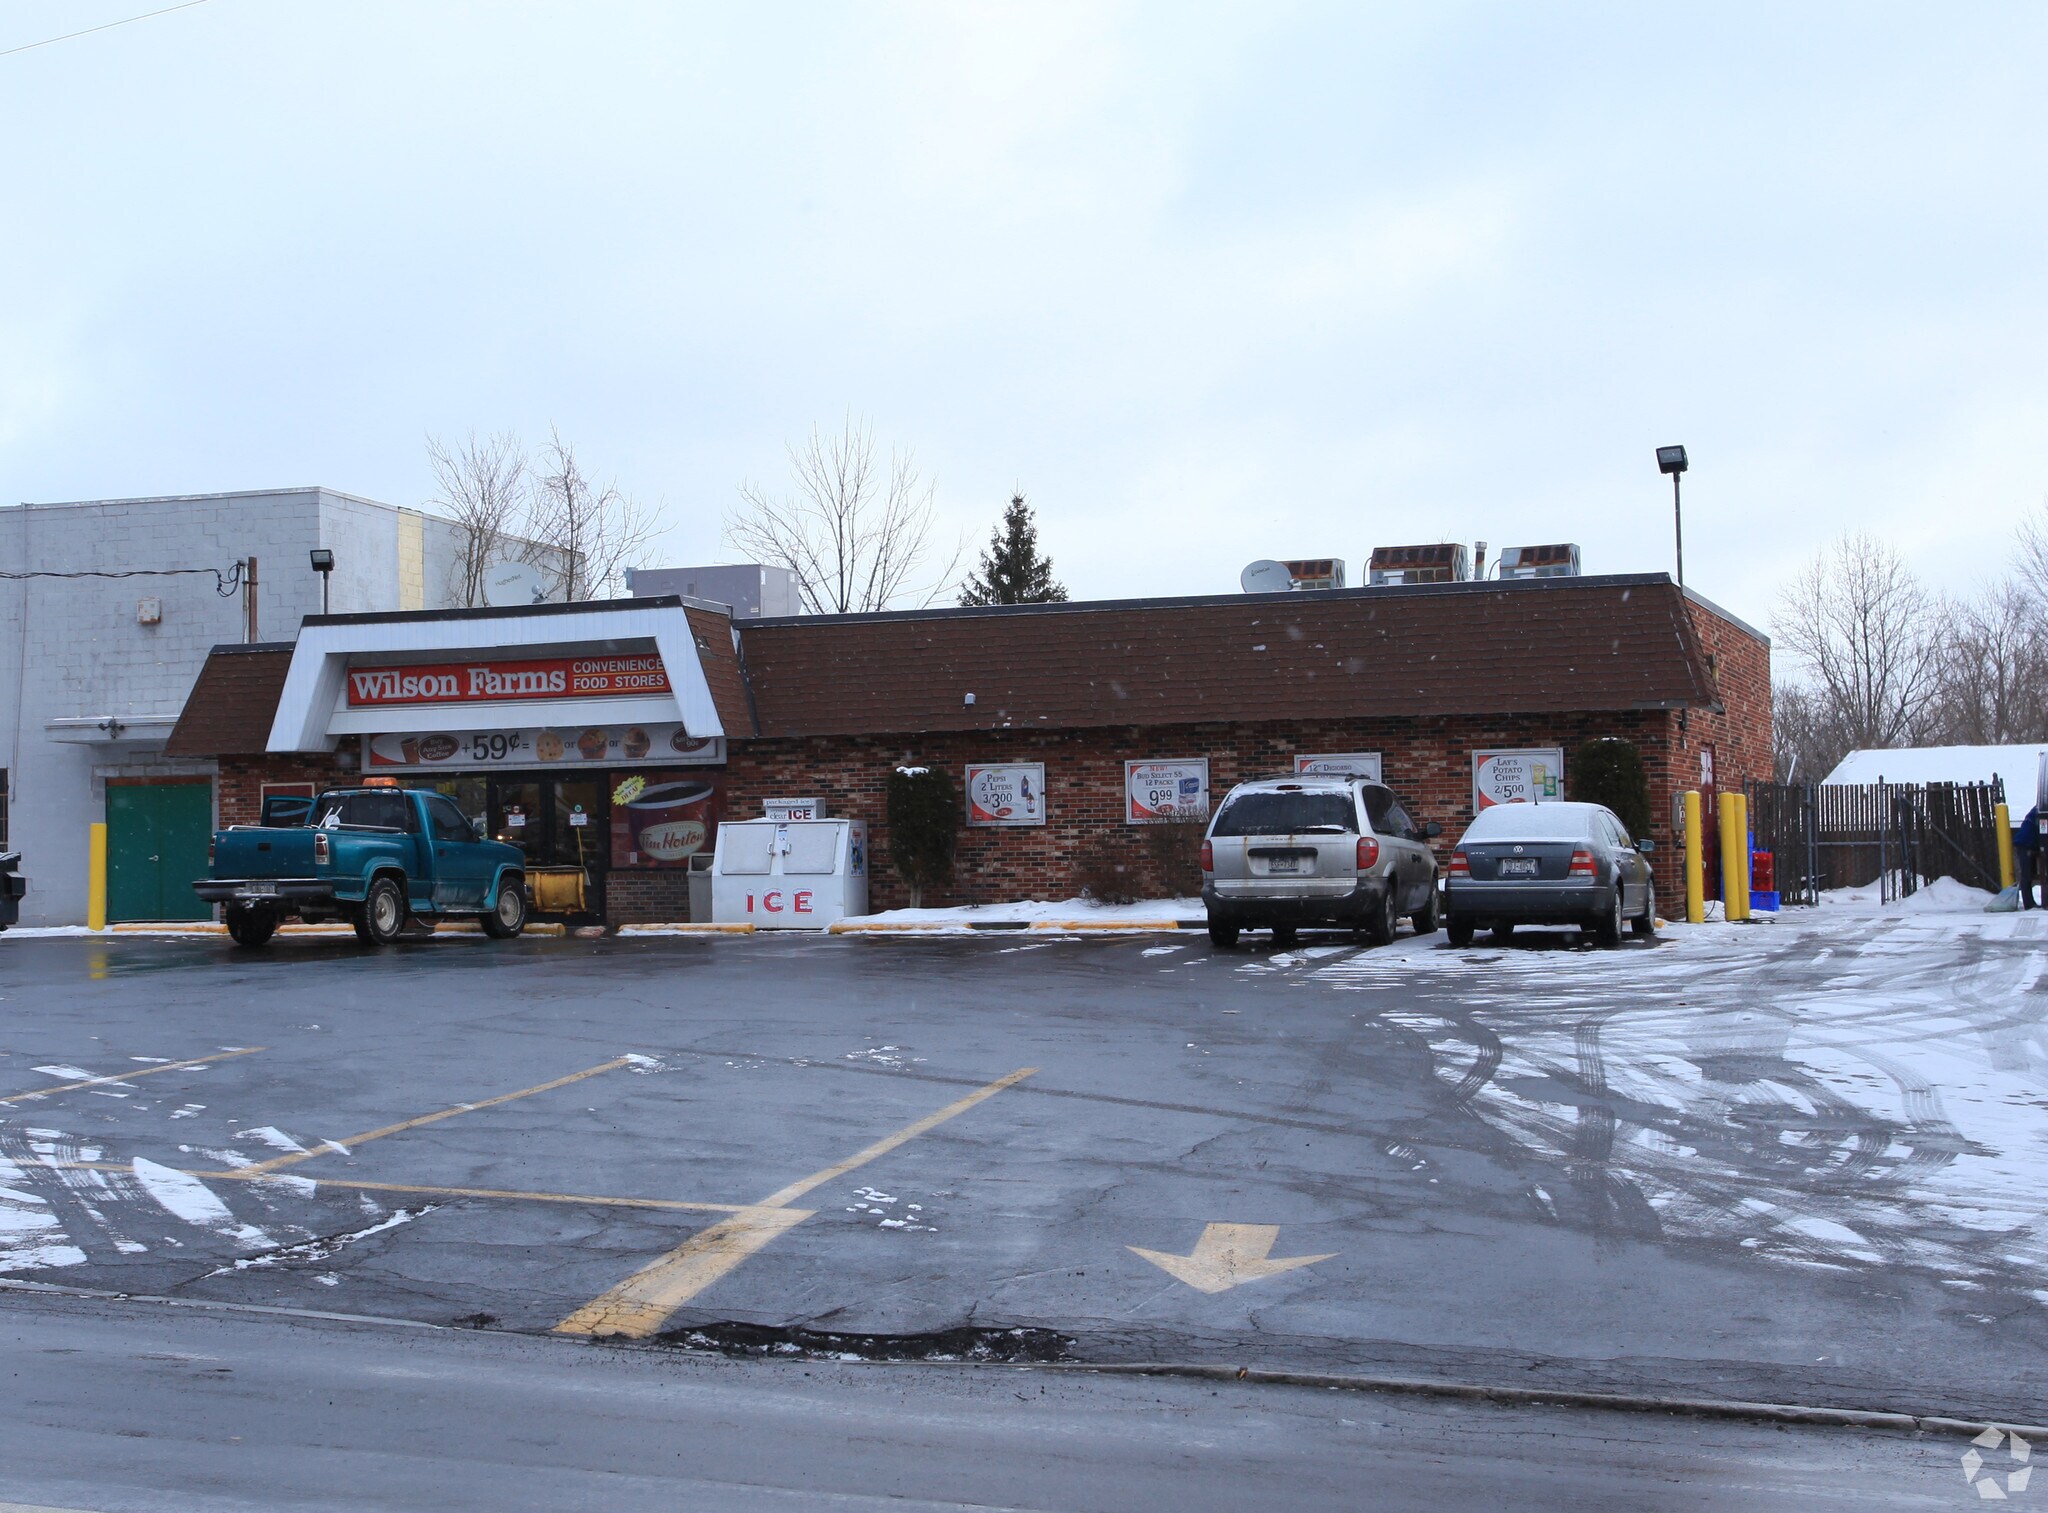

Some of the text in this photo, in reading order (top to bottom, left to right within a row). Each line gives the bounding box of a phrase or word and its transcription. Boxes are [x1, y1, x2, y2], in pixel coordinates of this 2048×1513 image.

[573, 659, 664, 674] CONVENIENCE
[351, 668, 567, 699] Wilson Farms
[573, 675, 664, 689] FOOD STORES
[609, 739, 619, 747] or
[426, 750, 450, 759] Coffee
[981, 782, 987, 791] 2
[788, 809, 812, 820] ICE
[745, 888, 813, 914] ICE
